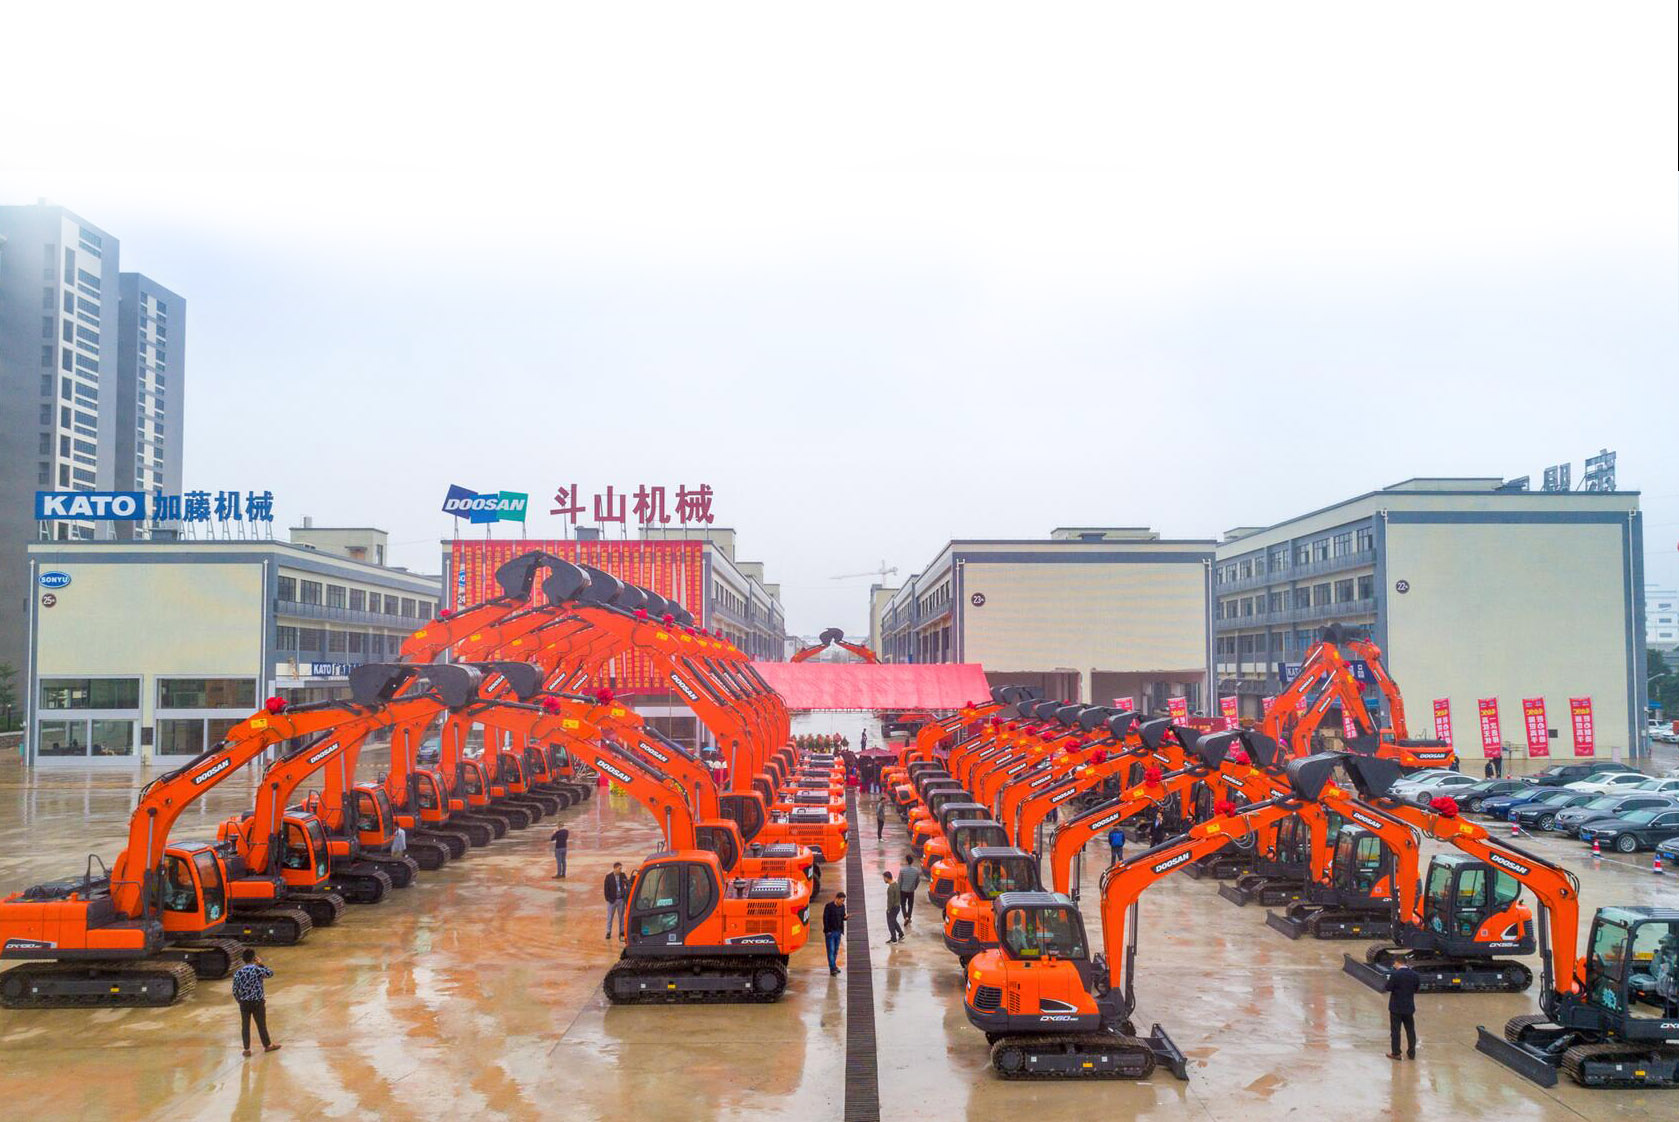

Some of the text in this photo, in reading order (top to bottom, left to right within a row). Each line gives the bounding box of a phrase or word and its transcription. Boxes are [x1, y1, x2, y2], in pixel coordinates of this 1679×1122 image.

[43, 490, 274, 523] KATO 加藤机械
[445, 498, 525, 511] DOOSAN
[549, 483, 715, 525] 斗山机械
[313, 663, 332, 675] KATO
[670, 674, 698, 701] DOOSAN
[310, 743, 339, 764] DOOSAN
[639, 742, 668, 762] DOOSAN
[195, 759, 230, 785] DOOSAN
[596, 759, 631, 782] DOOSAN
[1222, 774, 1244, 787] DOOSAN
[1052, 788, 1076, 803] DOOSAN
[1091, 812, 1119, 830] DOOSAN
[1353, 812, 1382, 829] DOOSAN
[1155, 852, 1190, 873] DOOSAN
[1490, 854, 1528, 875] DOOSAN
